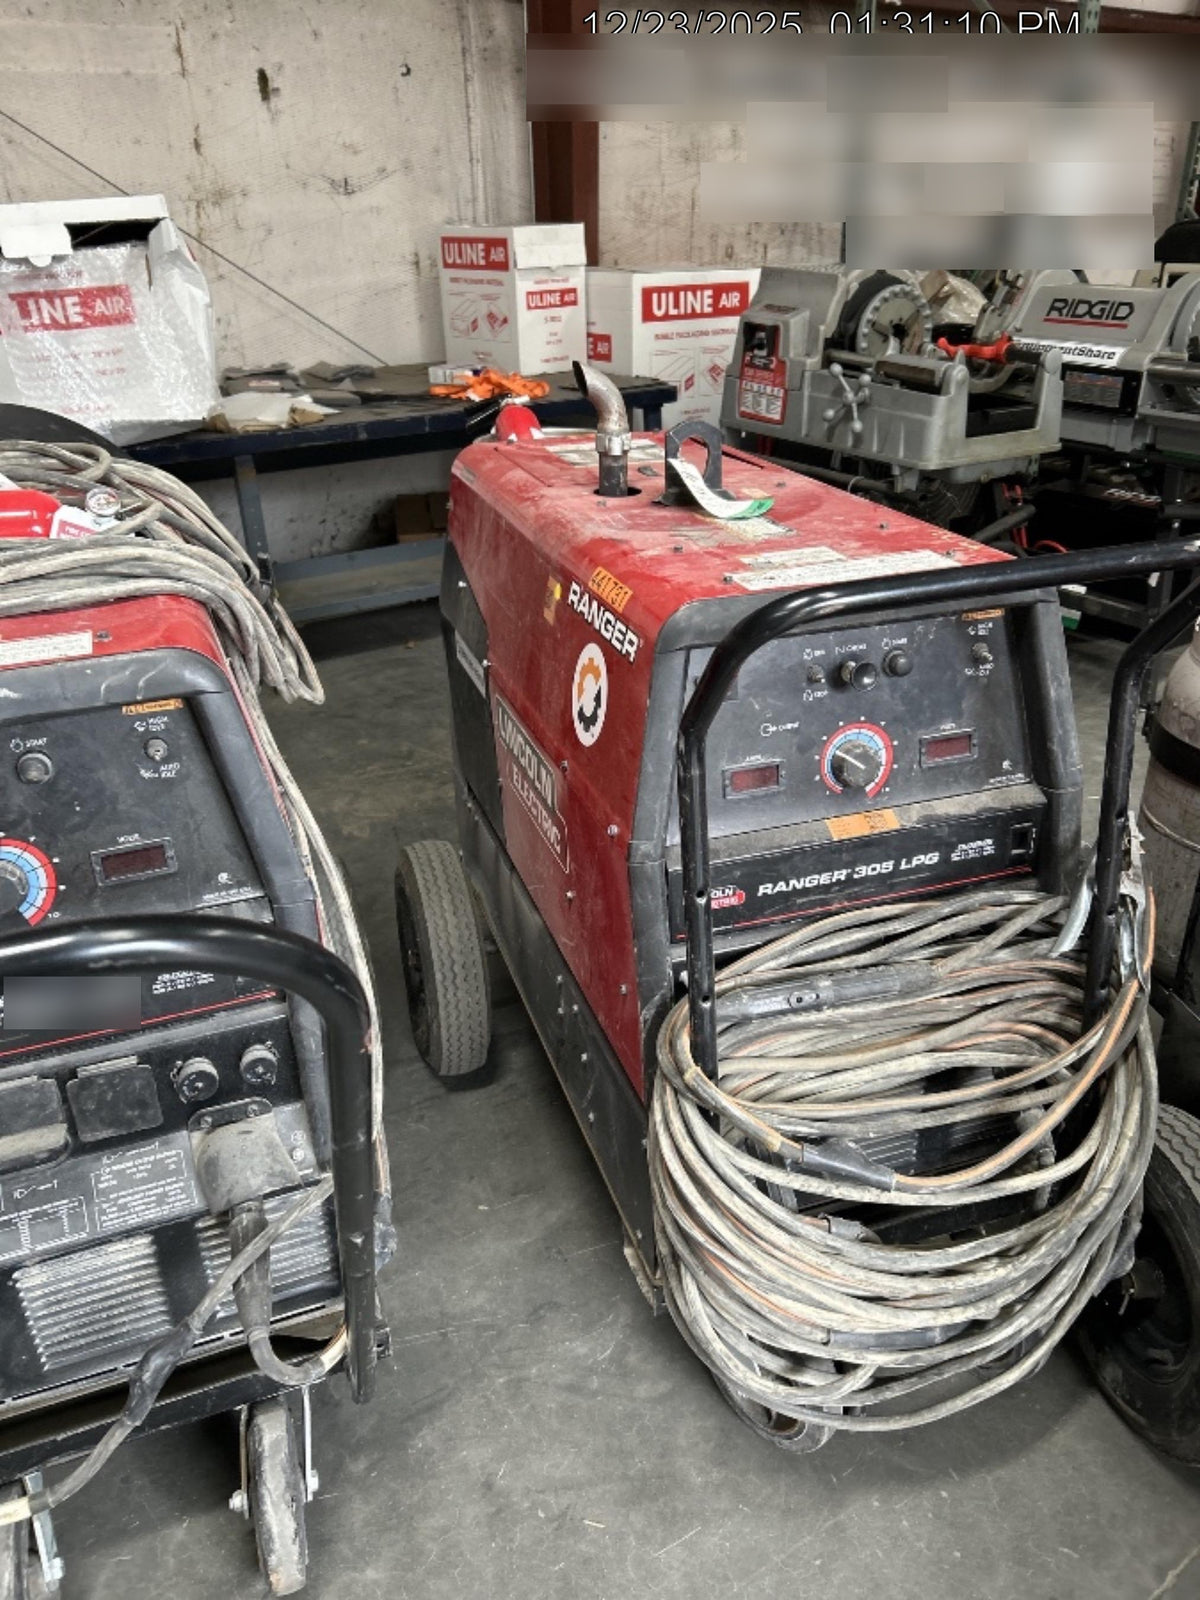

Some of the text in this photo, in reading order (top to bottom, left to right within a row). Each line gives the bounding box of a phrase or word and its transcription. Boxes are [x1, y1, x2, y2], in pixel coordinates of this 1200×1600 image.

[443, 242, 506, 266] ULINE AIR
[528, 292, 576, 307] ULINE AIR
[651, 289, 714, 317] ULINE
[718, 292, 741, 309] AIR
[1045, 298, 1135, 321] RIDGID
[567, 580, 639, 662] RANGER
[498, 706, 553, 808] LINCOLN
[757, 852, 941, 897] RANGER 305 LPG
